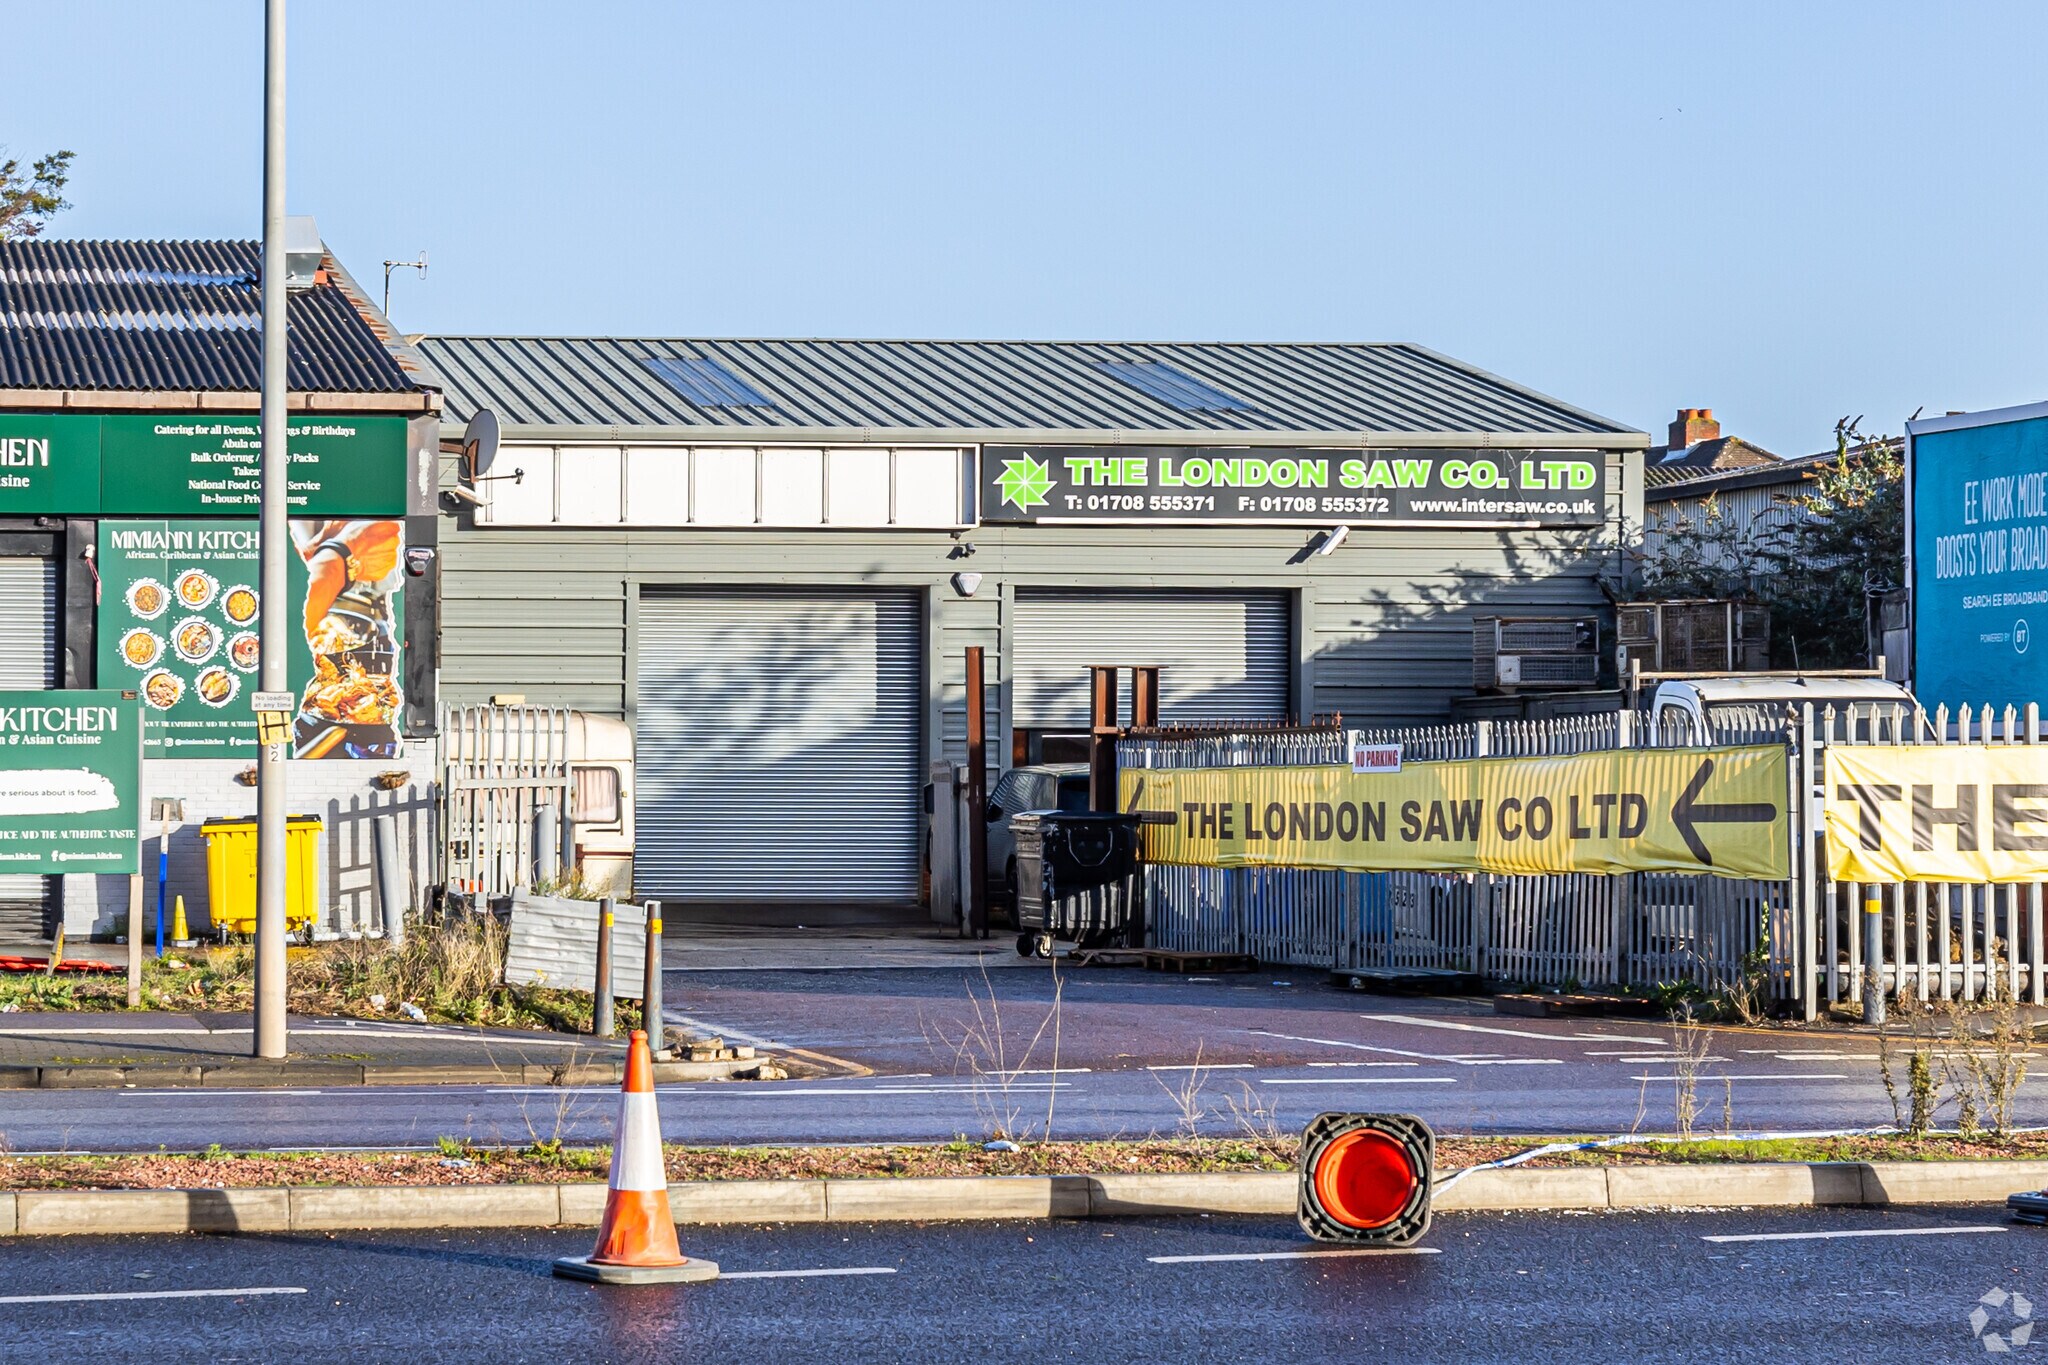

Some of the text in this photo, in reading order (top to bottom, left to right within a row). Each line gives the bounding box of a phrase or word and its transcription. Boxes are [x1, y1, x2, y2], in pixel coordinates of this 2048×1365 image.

[154, 425, 194, 437] Catering
[195, 425, 209, 435] for
[210, 425, 222, 435] all
[223, 425, 256, 436] Events,
[312, 426, 356, 437] Birthdays
[222, 439, 248, 449] Abula
[191, 453, 212, 462] Bulk
[213, 453, 254, 464] Ordering
[293, 453, 319, 463] Packs
[232, 466, 261, 476] Takea
[1064, 457, 1596, 490] THE LONDON SAW CO. LTD
[188, 480, 226, 490] National
[227, 480, 250, 490] Food
[287, 481, 321, 490] Service
[201, 494, 242, 504] In-house
[244, 494, 261, 504] Priv
[1065, 495, 1596, 513] T: 01708 555371 F: 01708 555372 www.intersaw.co.uk
[1965, 472, 2048, 525] EE WORK MODE
[111, 531, 260, 550] MIMIANN KITCH
[125, 552, 158, 560] African,
[160, 552, 202, 560] Caribbean
[213, 552, 236, 560] Asian
[236, 552, 260, 560] Cuisi
[1936, 525, 2048, 579] BOOSTS YOUR BROAD
[1963, 590, 2048, 609] SEARCH EE BROADBAND
[1980, 633, 2011, 643] POWERED BY
[2016, 630, 2026, 643] BT
[0, 707, 117, 732] KITCHEN
[22, 734, 54, 745] Asian
[57, 734, 102, 744] Cuisine
[1355, 750, 1398, 767] NO PARKING
[41, 789, 66, 797] about
[69, 789, 75, 797] is
[77, 789, 98, 797] food.
[1183, 793, 1648, 842] THE LONDON SAW CO LTD
[1838, 784, 2048, 851] THE
[109, 830, 136, 839] TASTE
